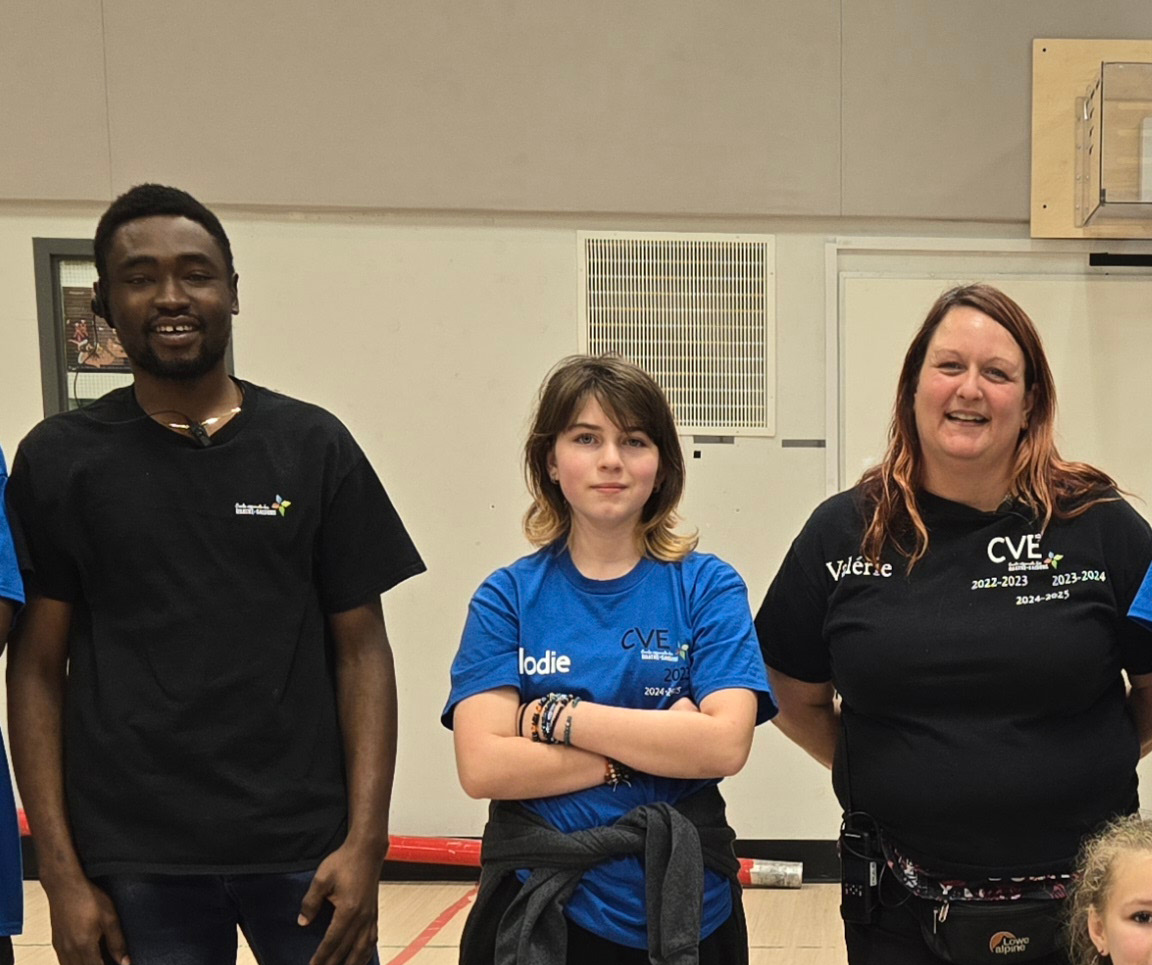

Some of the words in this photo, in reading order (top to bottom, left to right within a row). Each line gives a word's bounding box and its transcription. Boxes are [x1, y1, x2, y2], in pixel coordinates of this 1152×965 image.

[987, 533, 1043, 563] CVE
[971, 575, 1028, 590] 2022-2023
[1051, 570, 1106, 587] 2023-2024
[1015, 590, 1070, 605] 2024-2025
[621, 627, 671, 650] CVE
